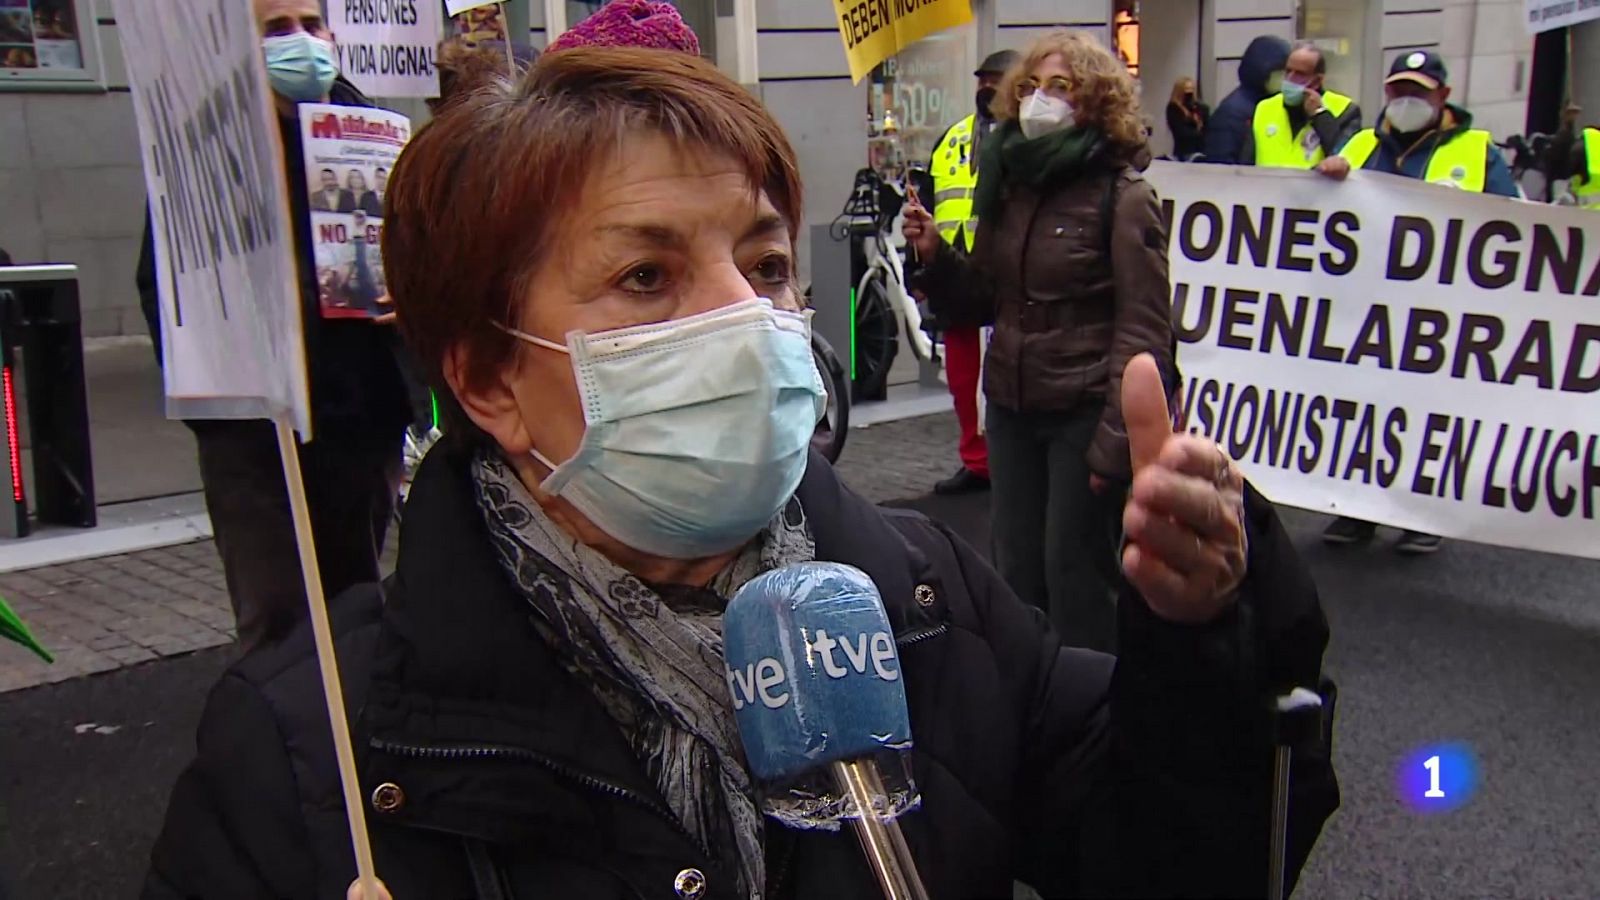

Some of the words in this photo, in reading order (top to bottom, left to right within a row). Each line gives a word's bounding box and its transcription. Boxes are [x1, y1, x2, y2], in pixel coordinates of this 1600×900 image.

[345, 0, 417, 25] PENSIONES
[842, 0, 890, 49] DEBEN
[348, 44, 377, 75] VIDA
[381, 45, 433, 76] DIGNA!
[320, 224, 347, 243] NO
[1412, 413, 1481, 501] EN
[814, 629, 898, 681] tve
